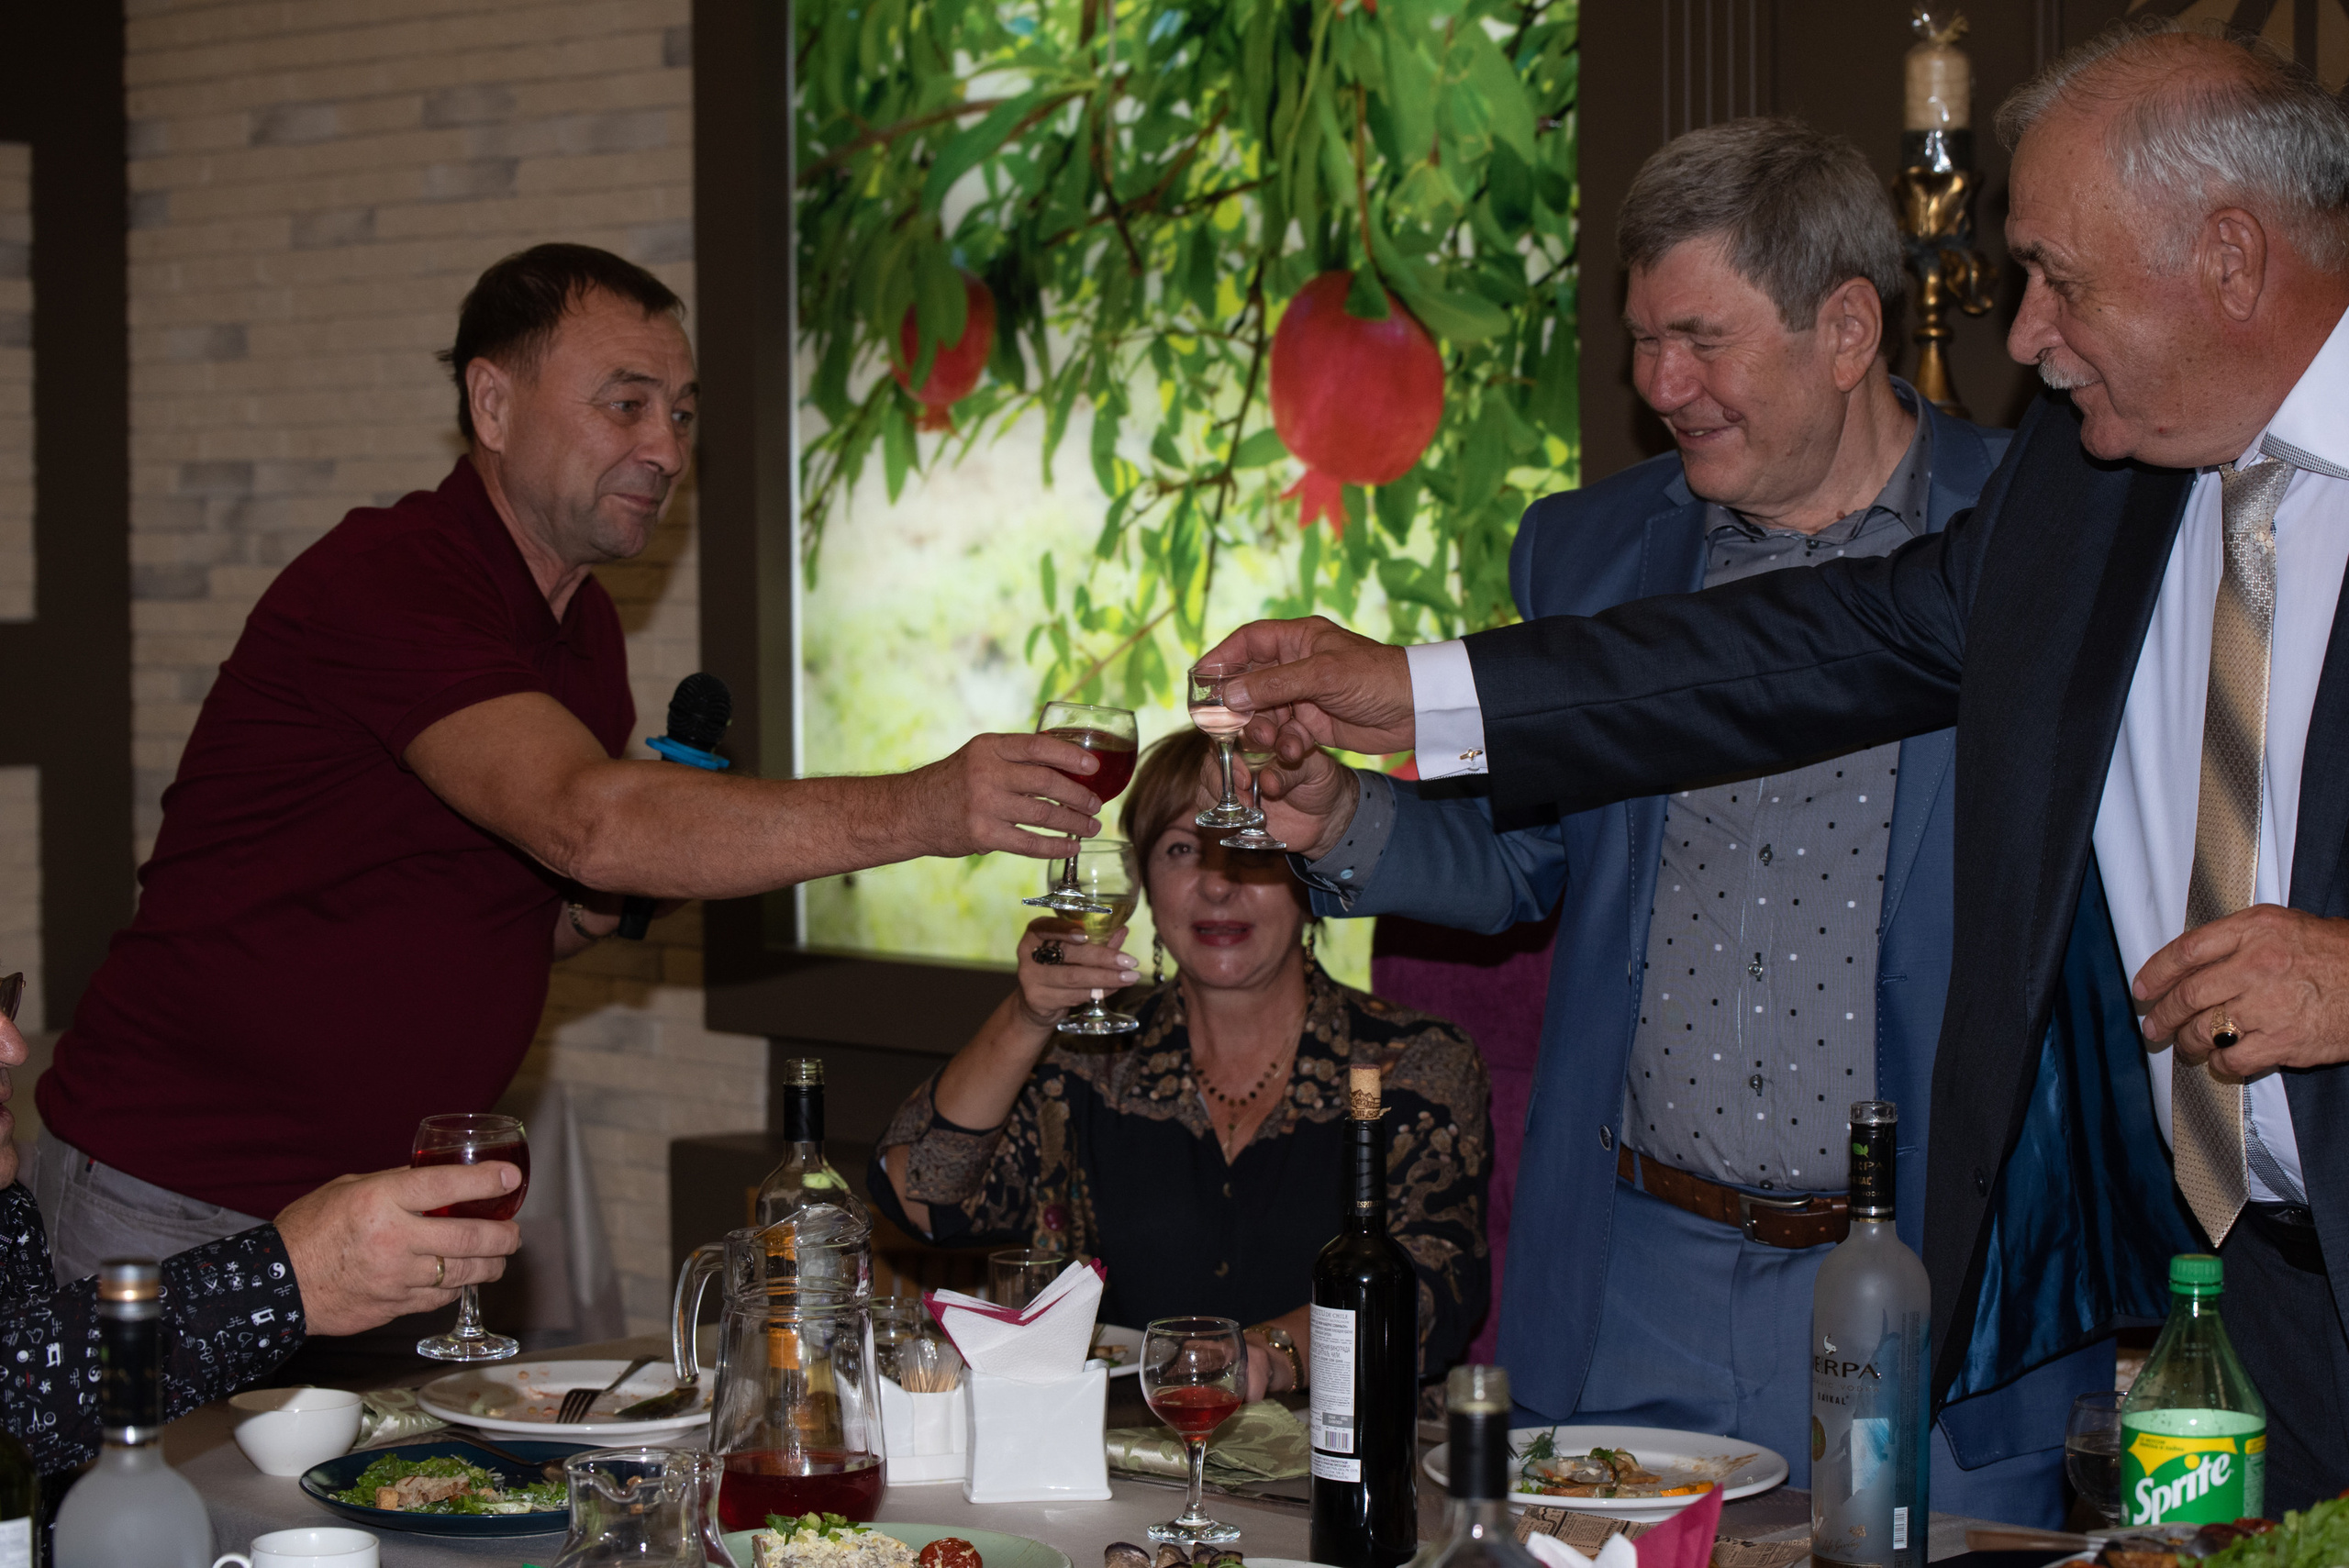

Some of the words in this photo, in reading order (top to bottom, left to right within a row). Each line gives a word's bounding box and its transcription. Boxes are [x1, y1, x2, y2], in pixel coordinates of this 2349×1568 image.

[1813, 1355, 1880, 1380] ERPA
[1840, 1384, 1880, 1393] VODKA
[2133, 1453, 2231, 1525] Sprite
